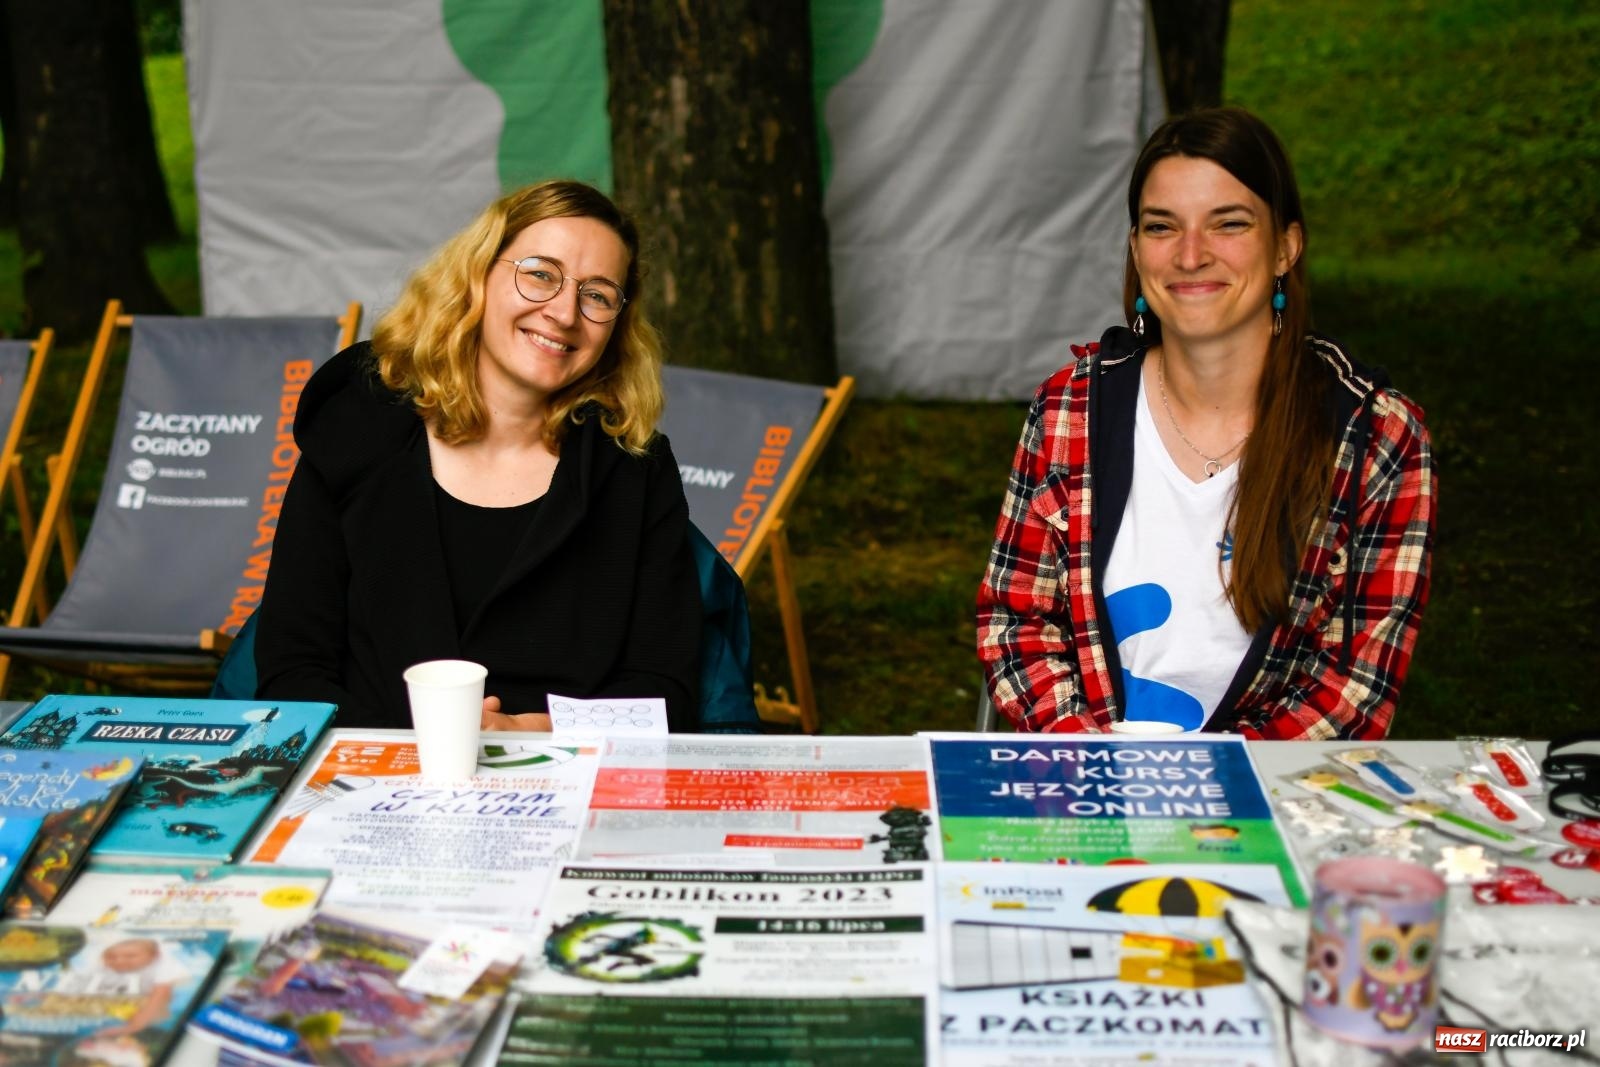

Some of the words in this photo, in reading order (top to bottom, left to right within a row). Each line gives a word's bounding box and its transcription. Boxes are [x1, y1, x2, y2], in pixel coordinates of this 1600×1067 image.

[134, 410, 263, 434] ZACZYTANY
[131, 434, 212, 457] OGRÓD
[93, 725, 164, 740] RZEKA
[167, 728, 238, 742] CZASU
[989, 748, 1213, 763] DARMOWE
[1076, 766, 1216, 780] KURSY
[391, 788, 557, 804] CZYTAM
[990, 782, 1226, 800] JĘZYKOWE
[370, 801, 408, 812] W
[426, 803, 566, 818] KLUBIE
[1067, 801, 1232, 817] ONLINE
[586, 884, 781, 903] Goblikon
[799, 885, 895, 903] 2023
[983, 885, 1064, 897] InPost
[757, 918, 822, 933] 14-16
[1020, 986, 1208, 1011] KSIĄŻKI
[980, 1016, 1267, 1035] PACZKOMAT
